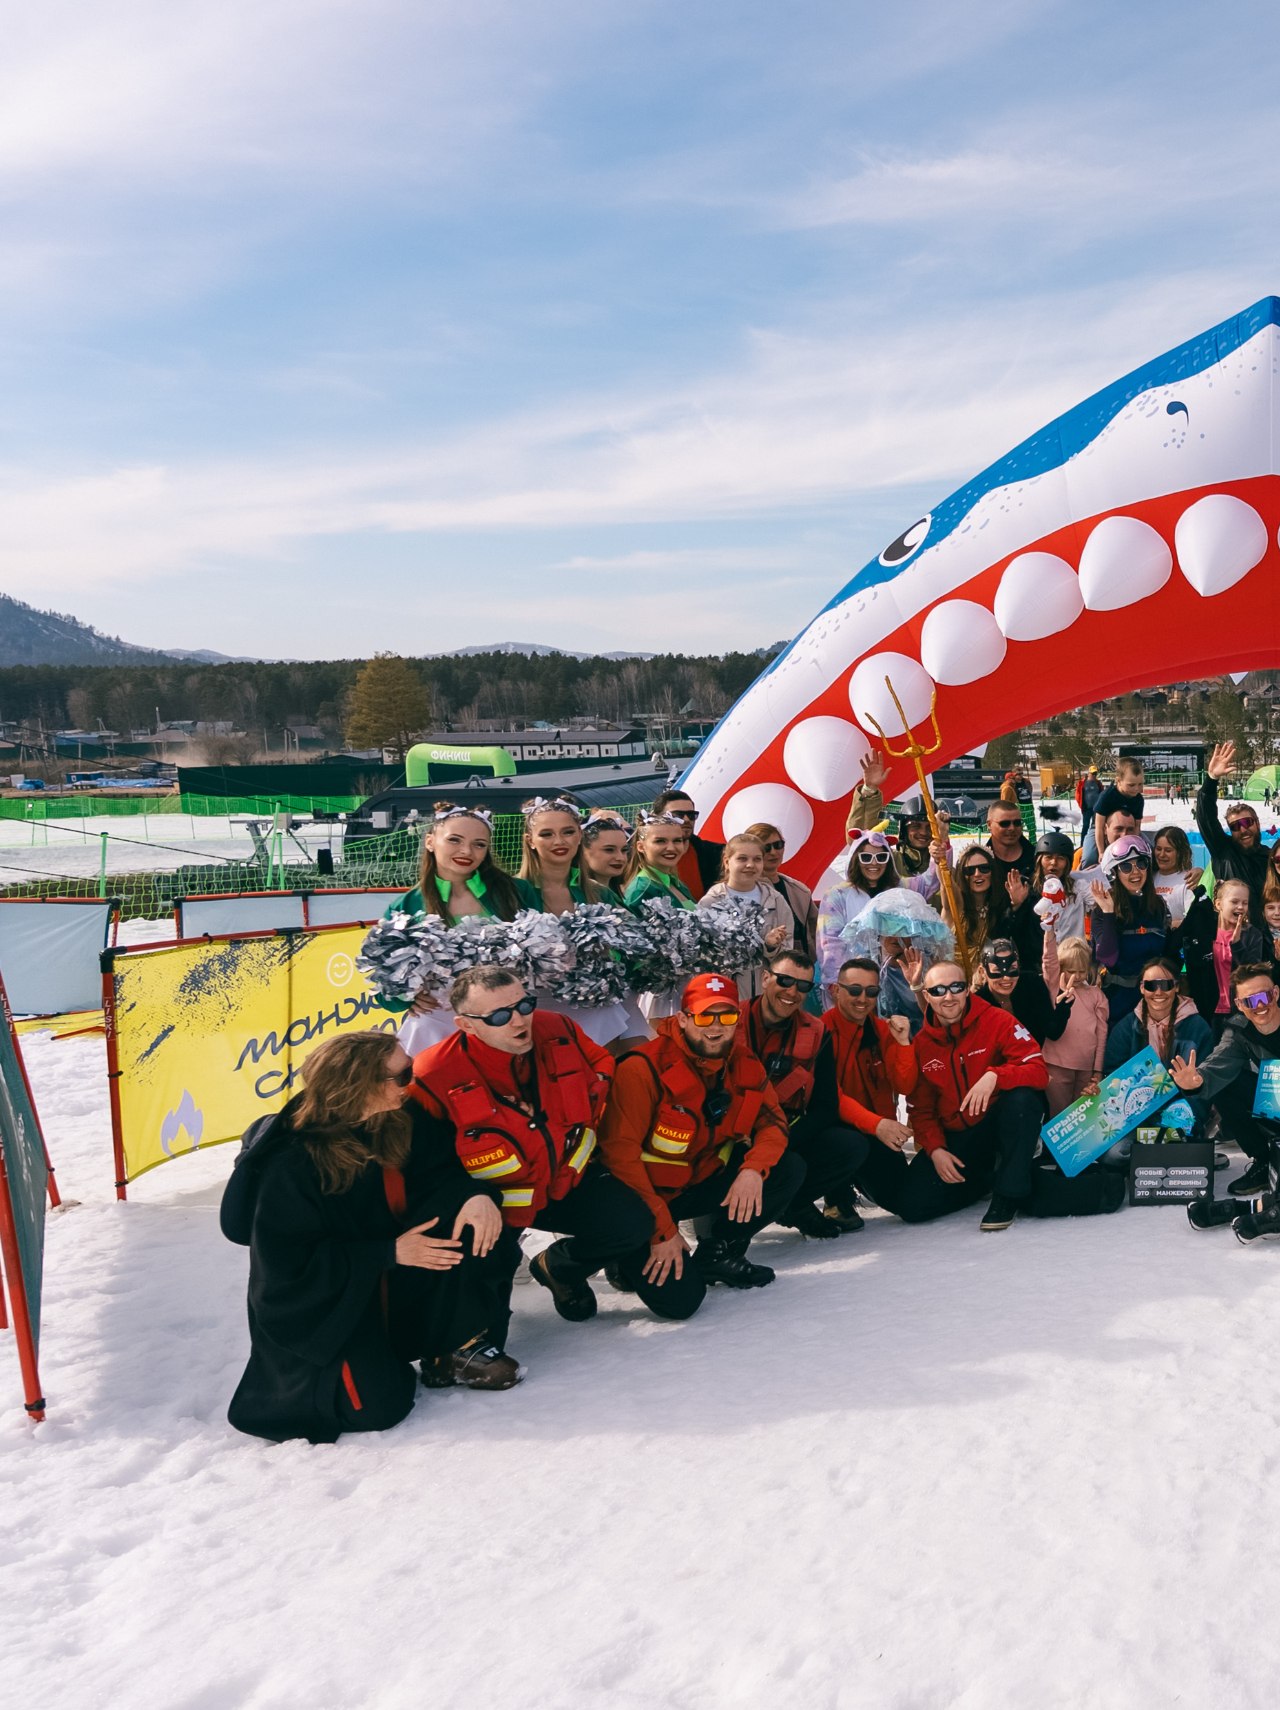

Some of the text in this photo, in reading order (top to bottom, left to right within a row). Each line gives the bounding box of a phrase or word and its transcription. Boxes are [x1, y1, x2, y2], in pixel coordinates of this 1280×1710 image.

[430, 750, 471, 761] ФИНИШ
[104, 1000, 112, 1039] LISKI
[1046, 1098, 1094, 1138] ПРЫЖОК
[1050, 1113, 1087, 1144] В ЛЕТО
[657, 1125, 690, 1140] РОМАН
[465, 1149, 505, 1167] АНДРЕЙ
